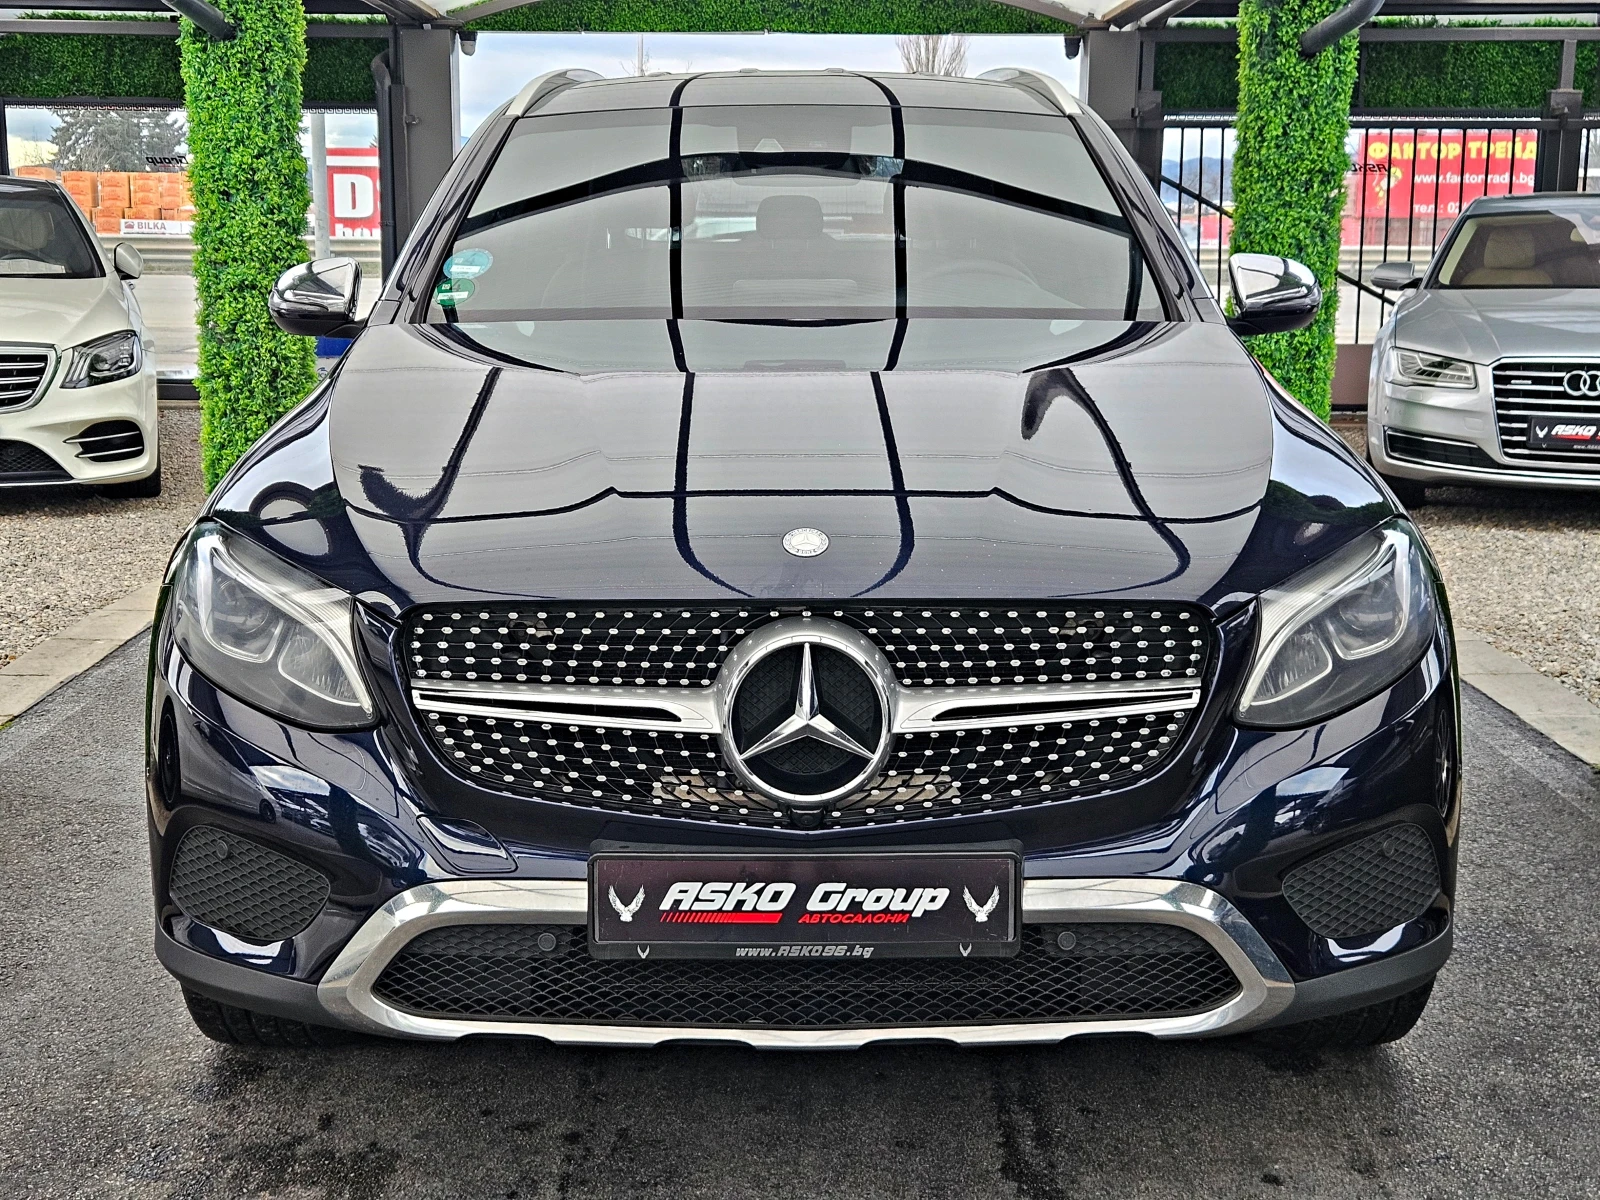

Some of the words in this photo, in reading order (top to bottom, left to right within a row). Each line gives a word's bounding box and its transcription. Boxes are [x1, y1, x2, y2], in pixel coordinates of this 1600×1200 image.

[1368, 142, 1461, 159] ФАКТОР
[1468, 137, 1537, 159] ТРЕЙД
[332, 173, 380, 218] D
[137, 221, 167, 230] BILKA
[1551, 424, 1597, 436] ASKO
[659, 882, 797, 911] ASKO
[806, 882, 950, 918] Group
[798, 913, 910, 924] АВТОСАЛОНИ
[735, 945, 874, 959] www.ASKO96.bg
